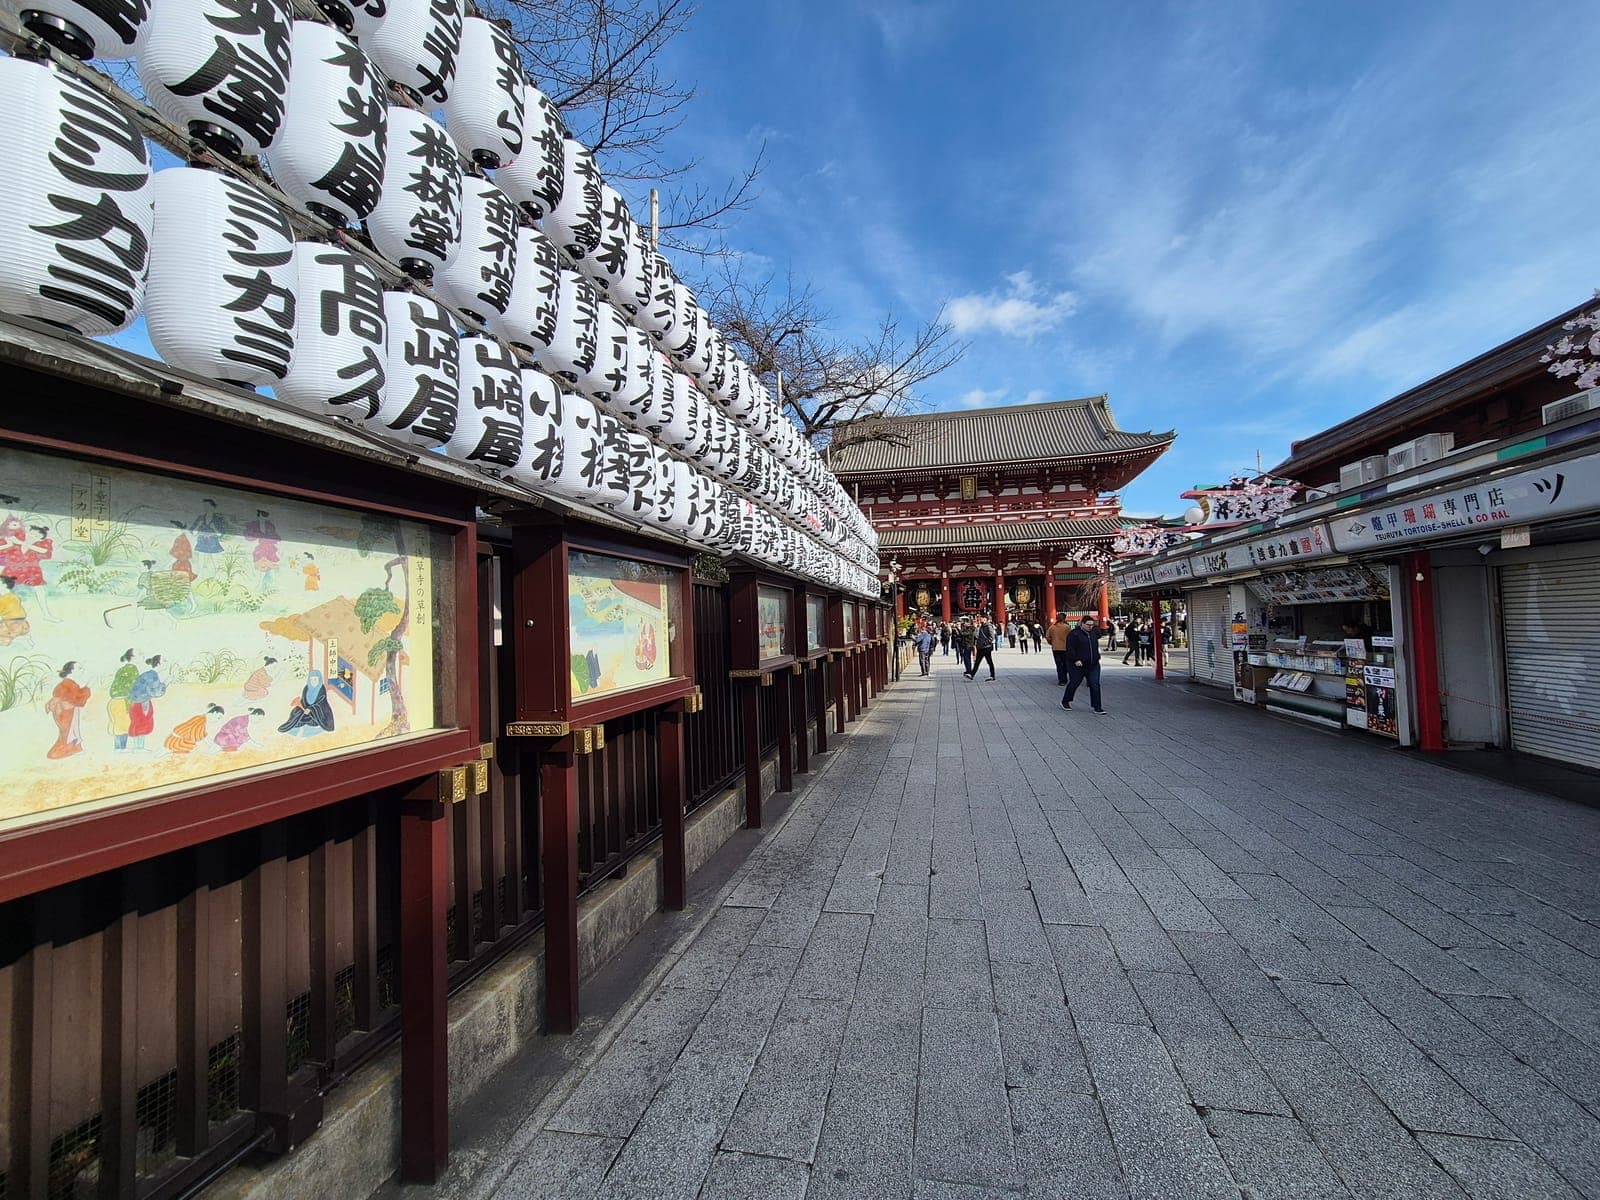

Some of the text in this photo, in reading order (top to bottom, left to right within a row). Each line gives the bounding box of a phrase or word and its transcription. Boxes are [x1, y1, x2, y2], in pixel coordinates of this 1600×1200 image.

[29, 73, 150, 327] ヨシカミ
[402, 123, 457, 262] 梅林堂
[220, 178, 294, 380] ヨシカミ
[530, 389, 564, 481] 小桜
[1532, 472, 1565, 505] ツ
[1375, 530, 1404, 542] TSURUYA
[1404, 518, 1465, 537] TORTOISE-SHELL
[1468, 516, 1474, 525] &
